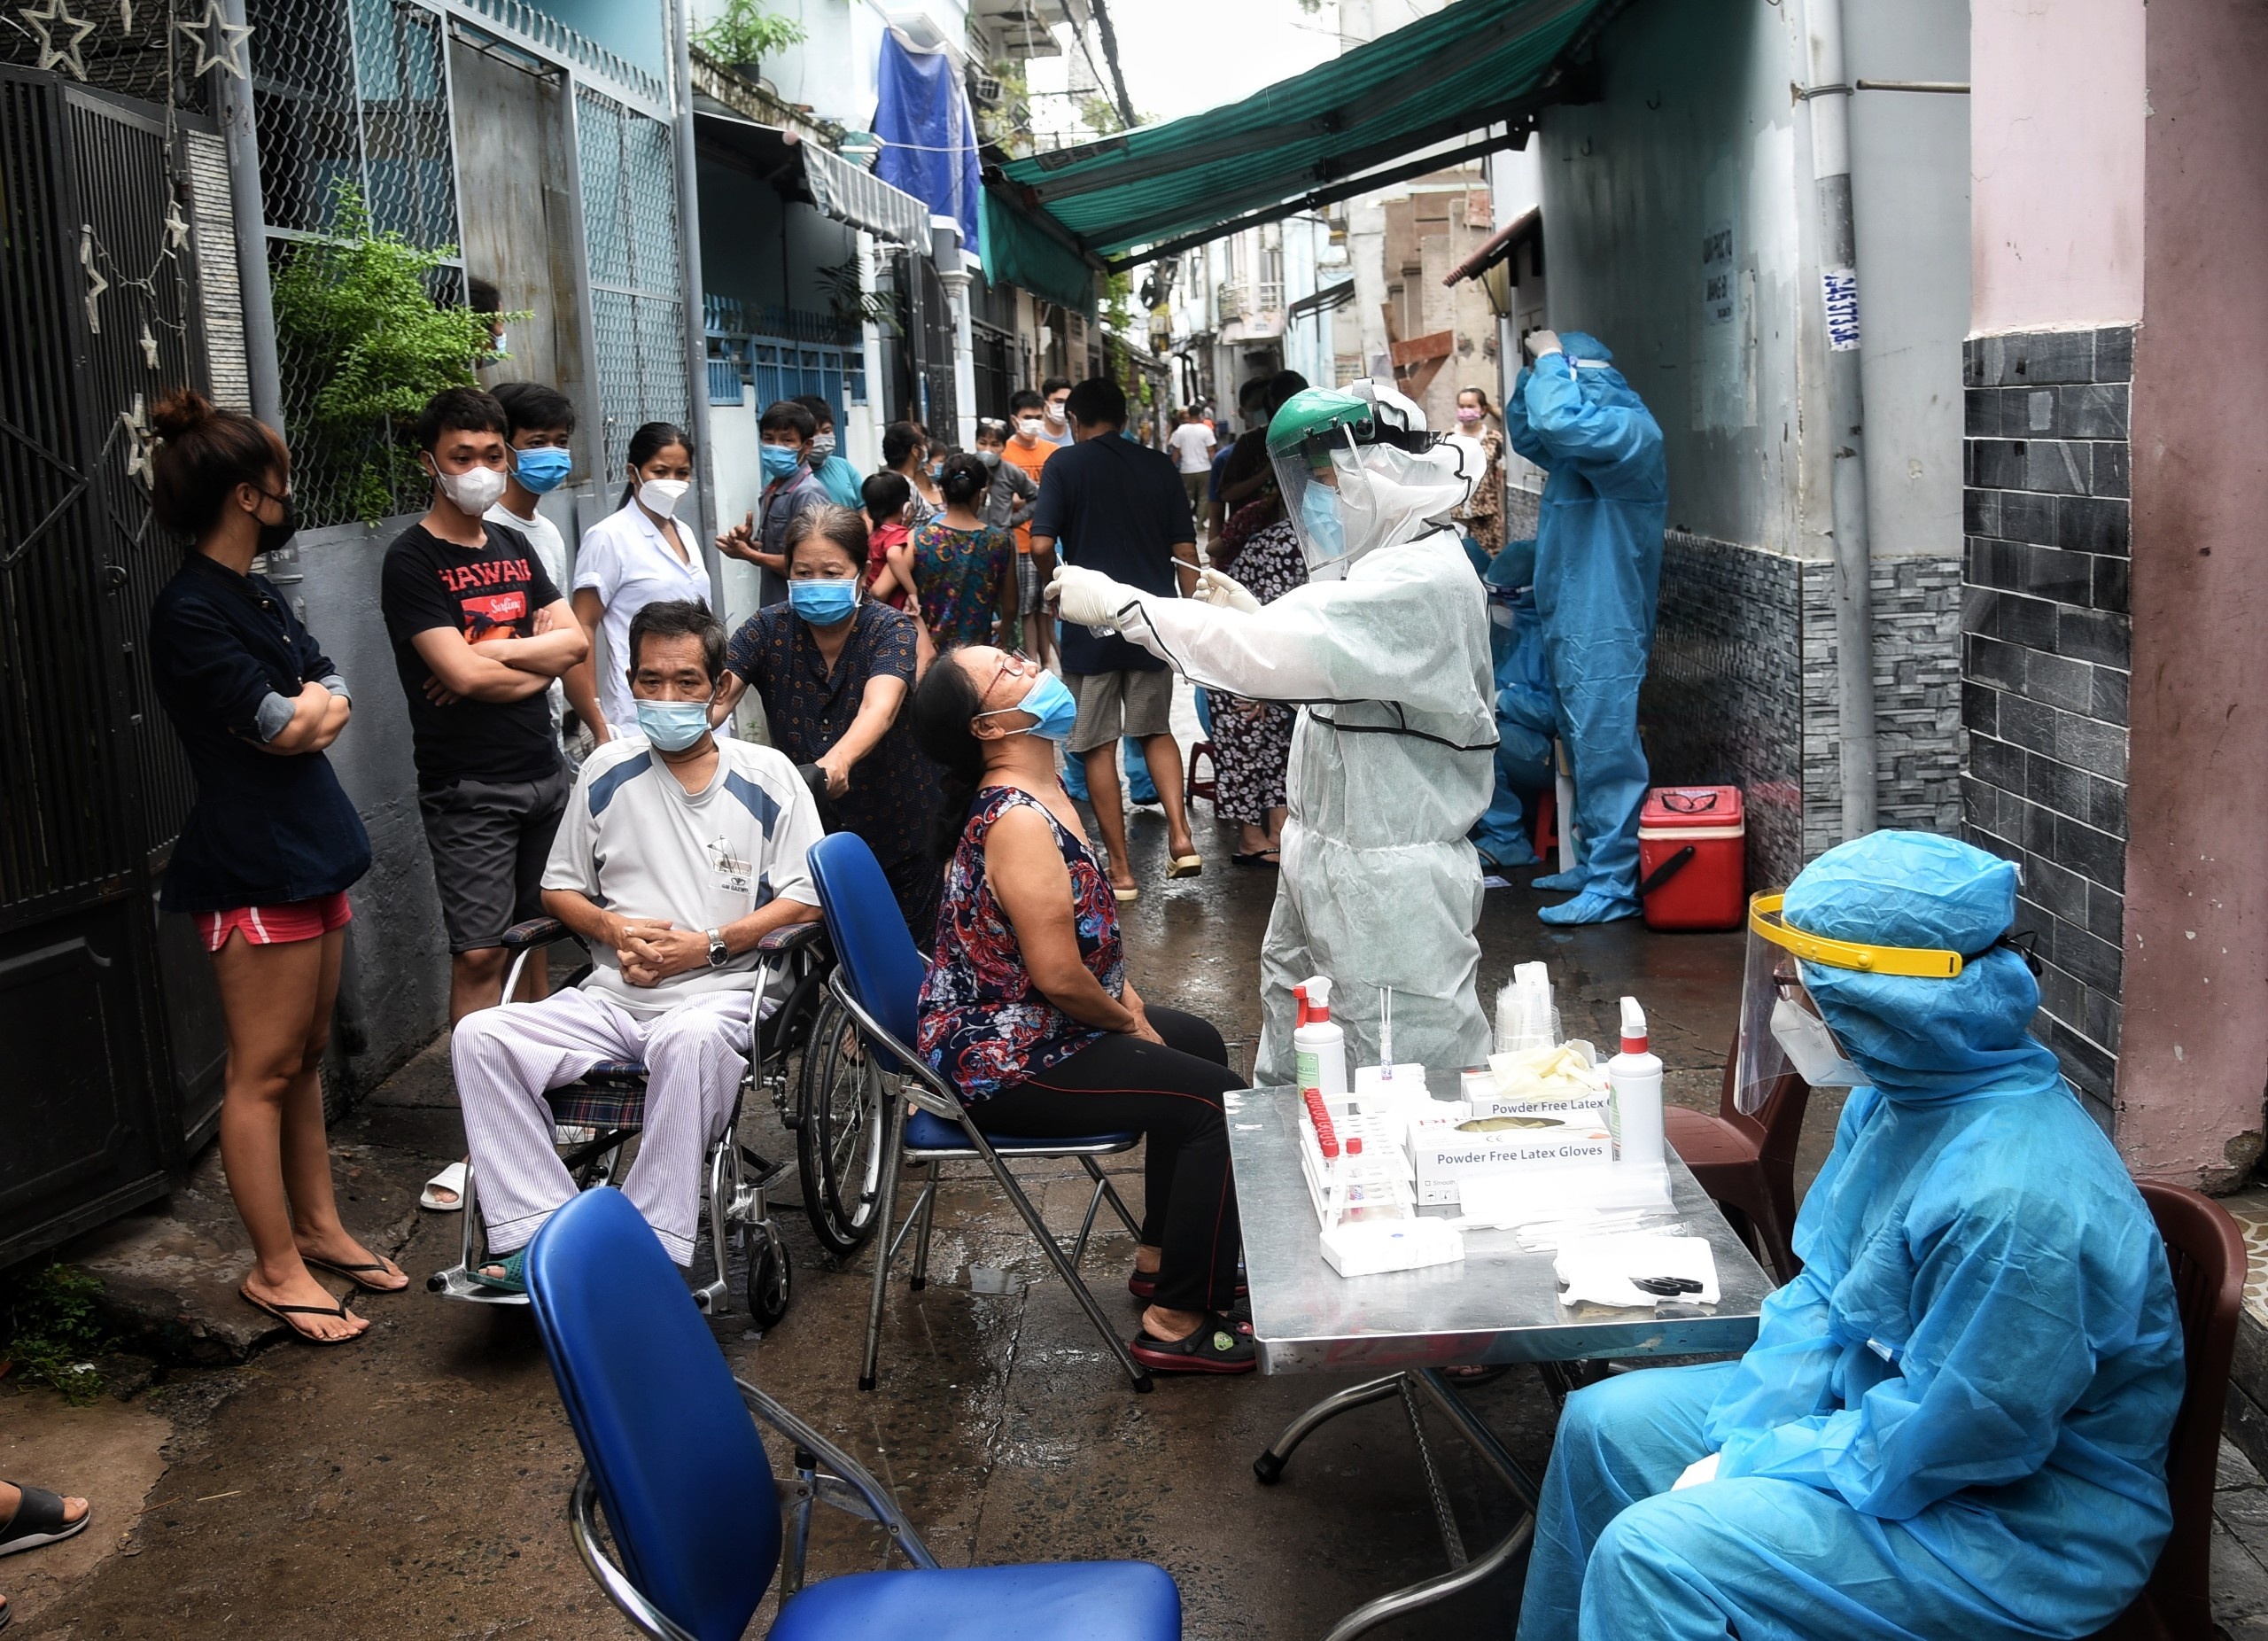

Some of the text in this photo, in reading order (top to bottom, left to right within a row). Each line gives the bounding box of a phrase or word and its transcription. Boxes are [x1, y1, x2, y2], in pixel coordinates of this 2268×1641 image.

[439, 558, 532, 592] HAWAII
[490, 597, 521, 614] Surfing
[1492, 1102, 1538, 1115] Powder
[1542, 1100, 1568, 1112] Free
[1571, 1099, 1604, 1109] Latex
[1437, 1145, 1603, 1164] Powder Free Latex Gloves
